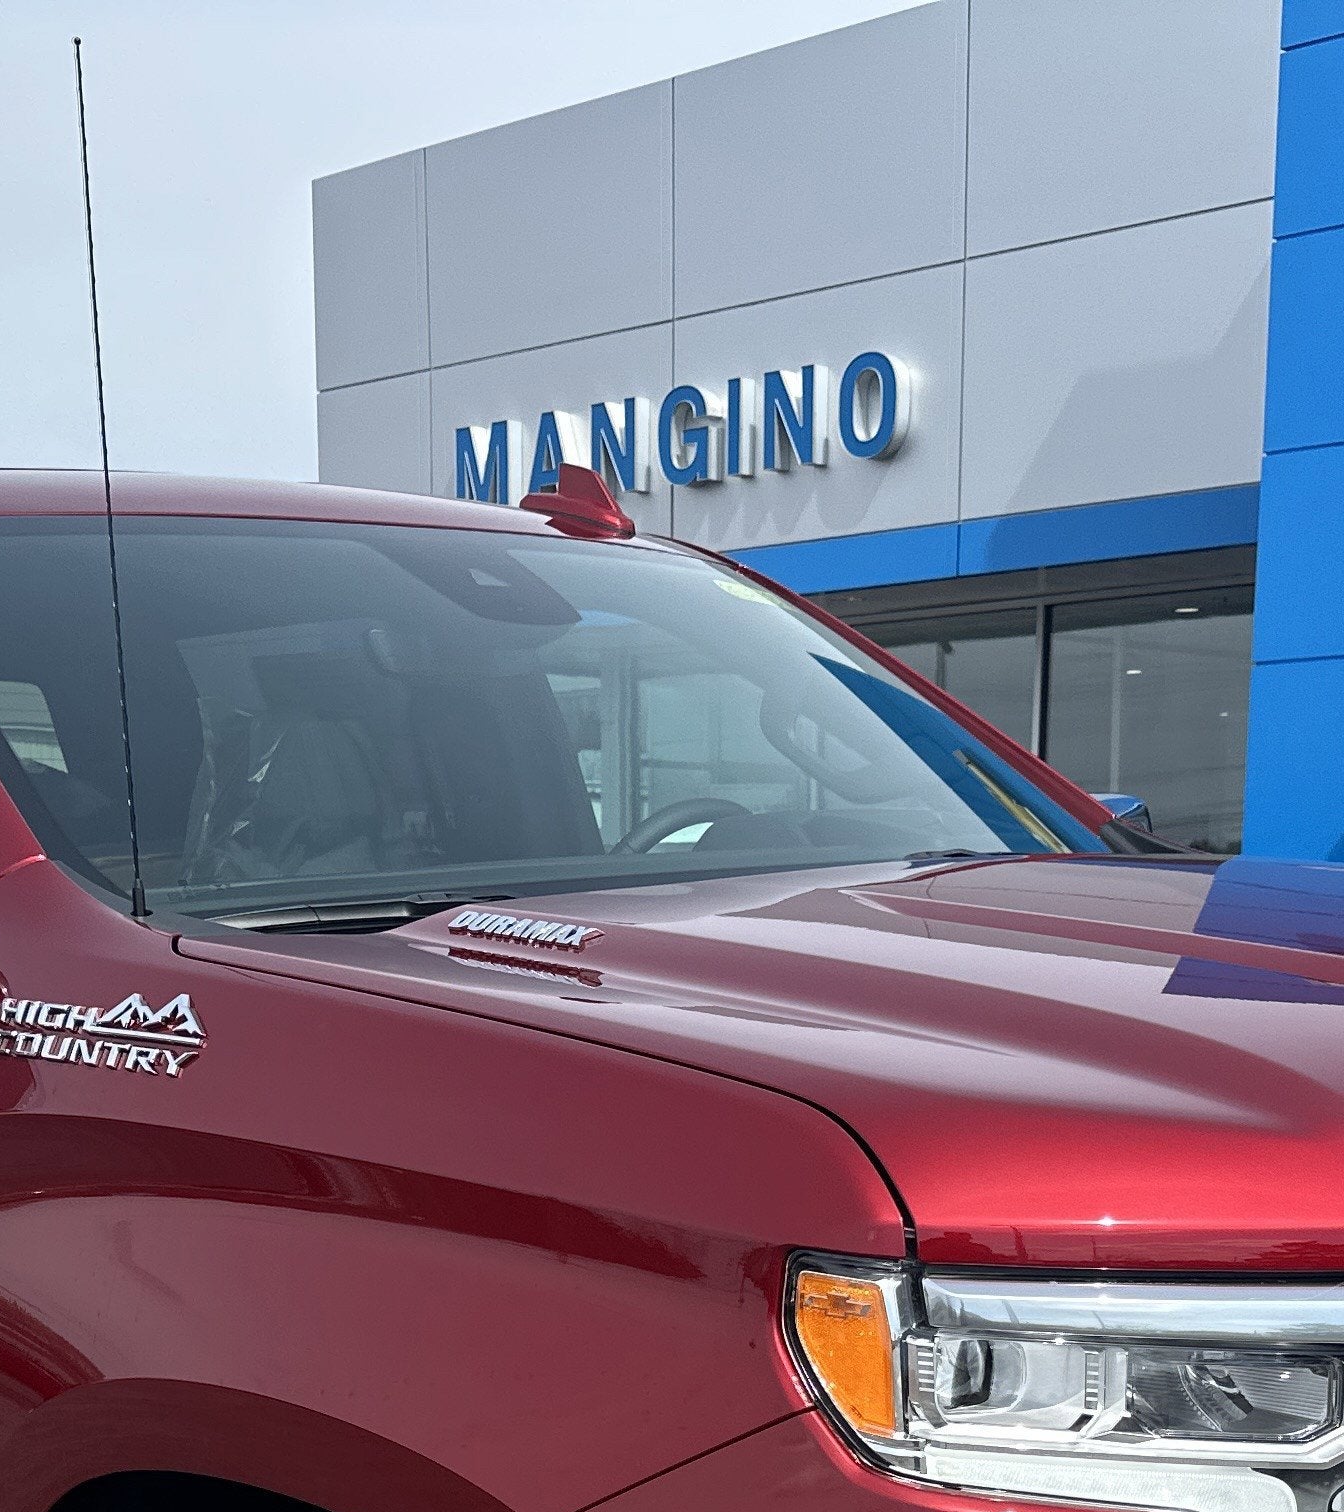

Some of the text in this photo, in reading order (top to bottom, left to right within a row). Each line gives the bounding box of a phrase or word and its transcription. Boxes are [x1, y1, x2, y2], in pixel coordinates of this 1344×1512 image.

[455, 352, 905, 506] MANGINO
[447, 910, 605, 953] DURAMAX
[0, 997, 104, 1034] HIGH
